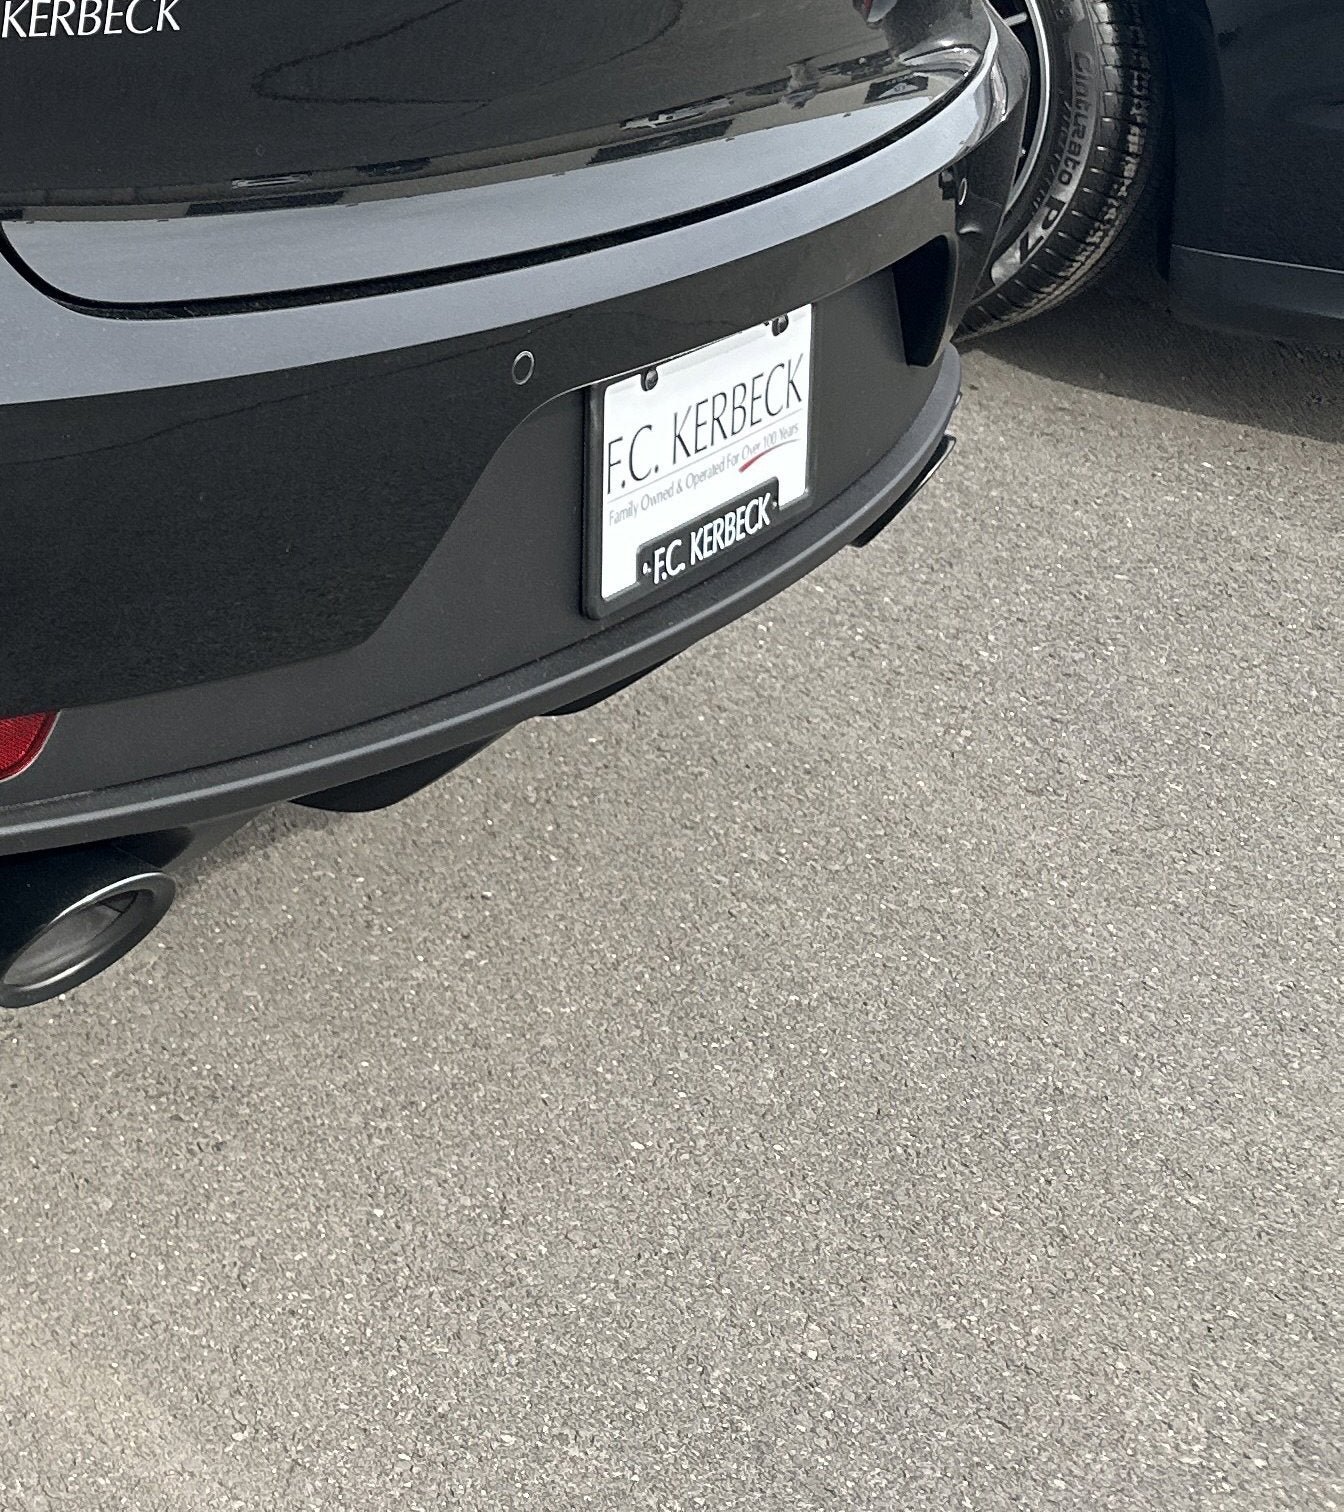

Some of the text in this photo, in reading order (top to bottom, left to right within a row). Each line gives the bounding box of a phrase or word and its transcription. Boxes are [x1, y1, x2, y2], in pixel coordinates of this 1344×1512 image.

[607, 352, 804, 494] F.C. KERBECK
[608, 499, 639, 526] Family
[640, 480, 675, 511] Owned
[685, 455, 725, 490] Operated
[726, 451, 740, 469] For
[741, 442, 761, 461] Over
[690, 492, 771, 566] KERBECK
